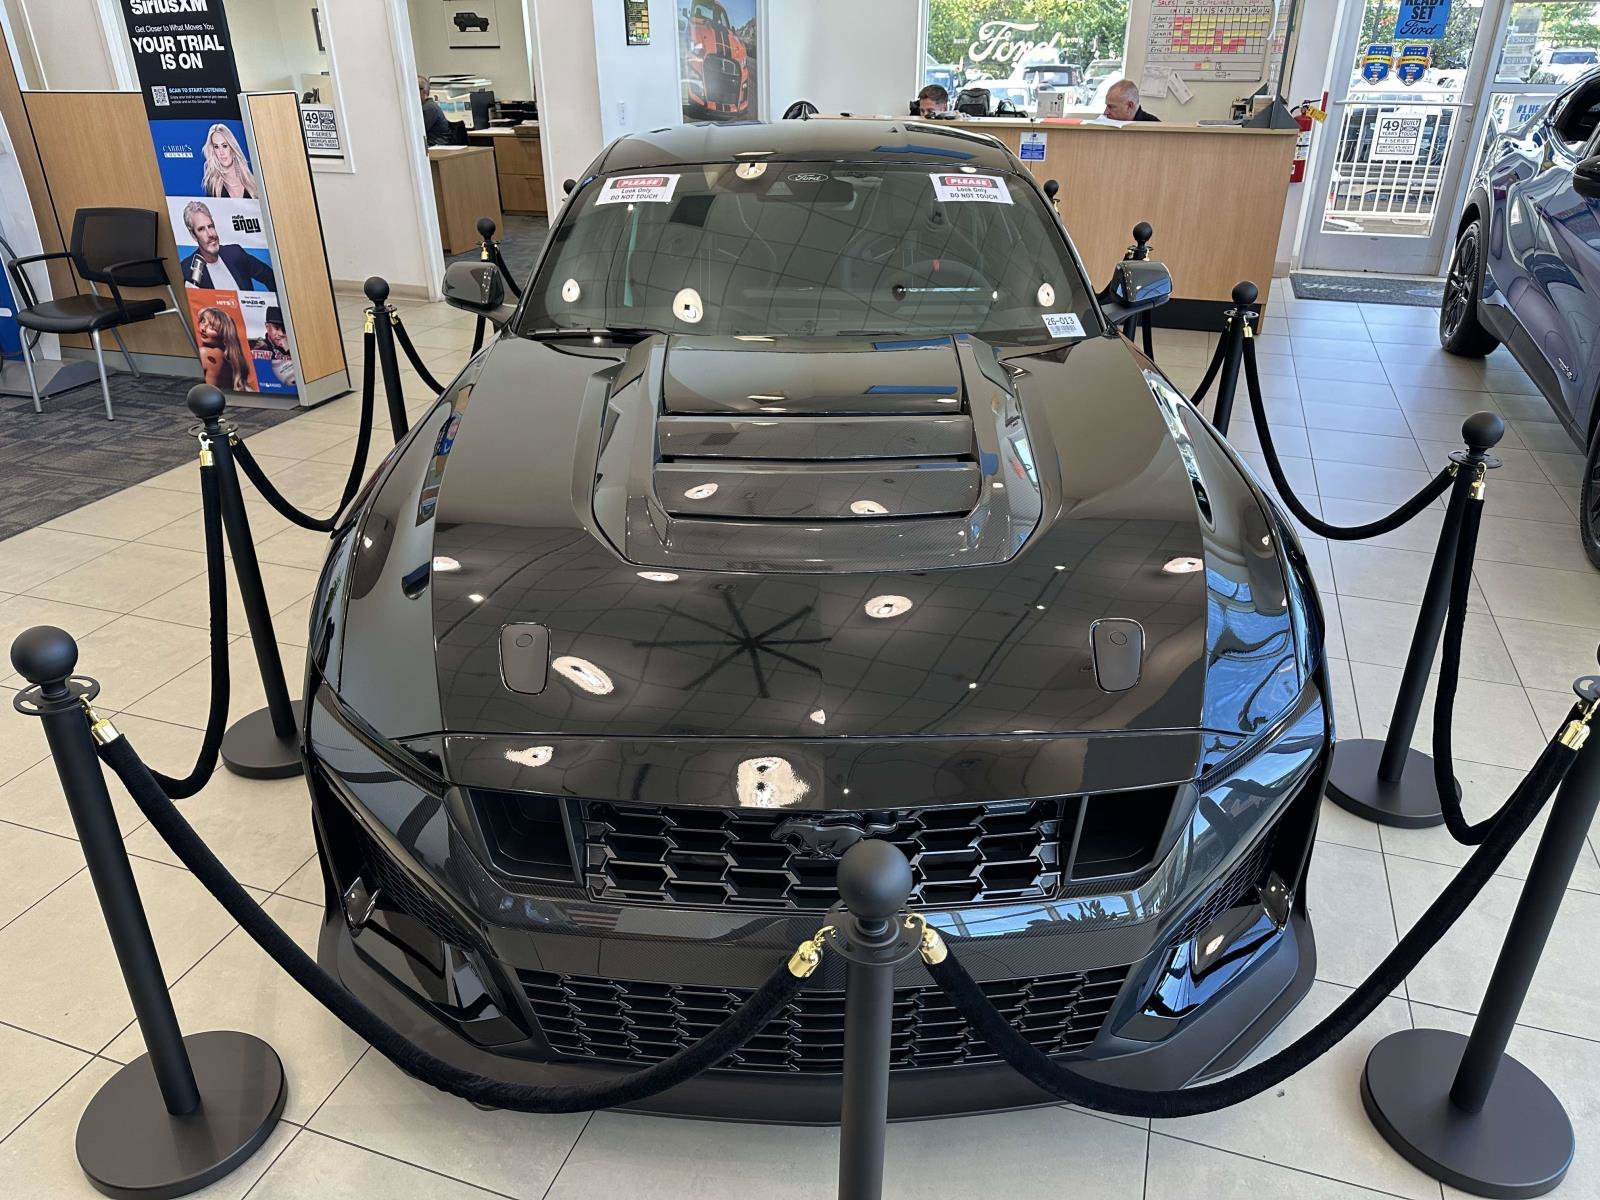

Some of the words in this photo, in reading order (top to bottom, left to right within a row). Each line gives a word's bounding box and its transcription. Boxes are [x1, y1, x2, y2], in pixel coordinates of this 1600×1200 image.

[129, 0, 208, 15] SiriusXM
[1411, 6, 1435, 19] SET
[135, 25, 145, 33] Get
[164, 24, 169, 32] to
[184, 23, 203, 31] Moves
[1400, 20, 1438, 35] Ford
[132, 35, 176, 53] YOUR
[176, 34, 225, 52] TRIAL
[968, 20, 1061, 62] Ford
[160, 53, 177, 70] IS
[178, 52, 203, 69] ON
[1516, 104, 1527, 113] #1
[305, 112, 319, 124] 49
[1383, 120, 1400, 131] 49
[1045, 316, 1075, 326] 26-013
